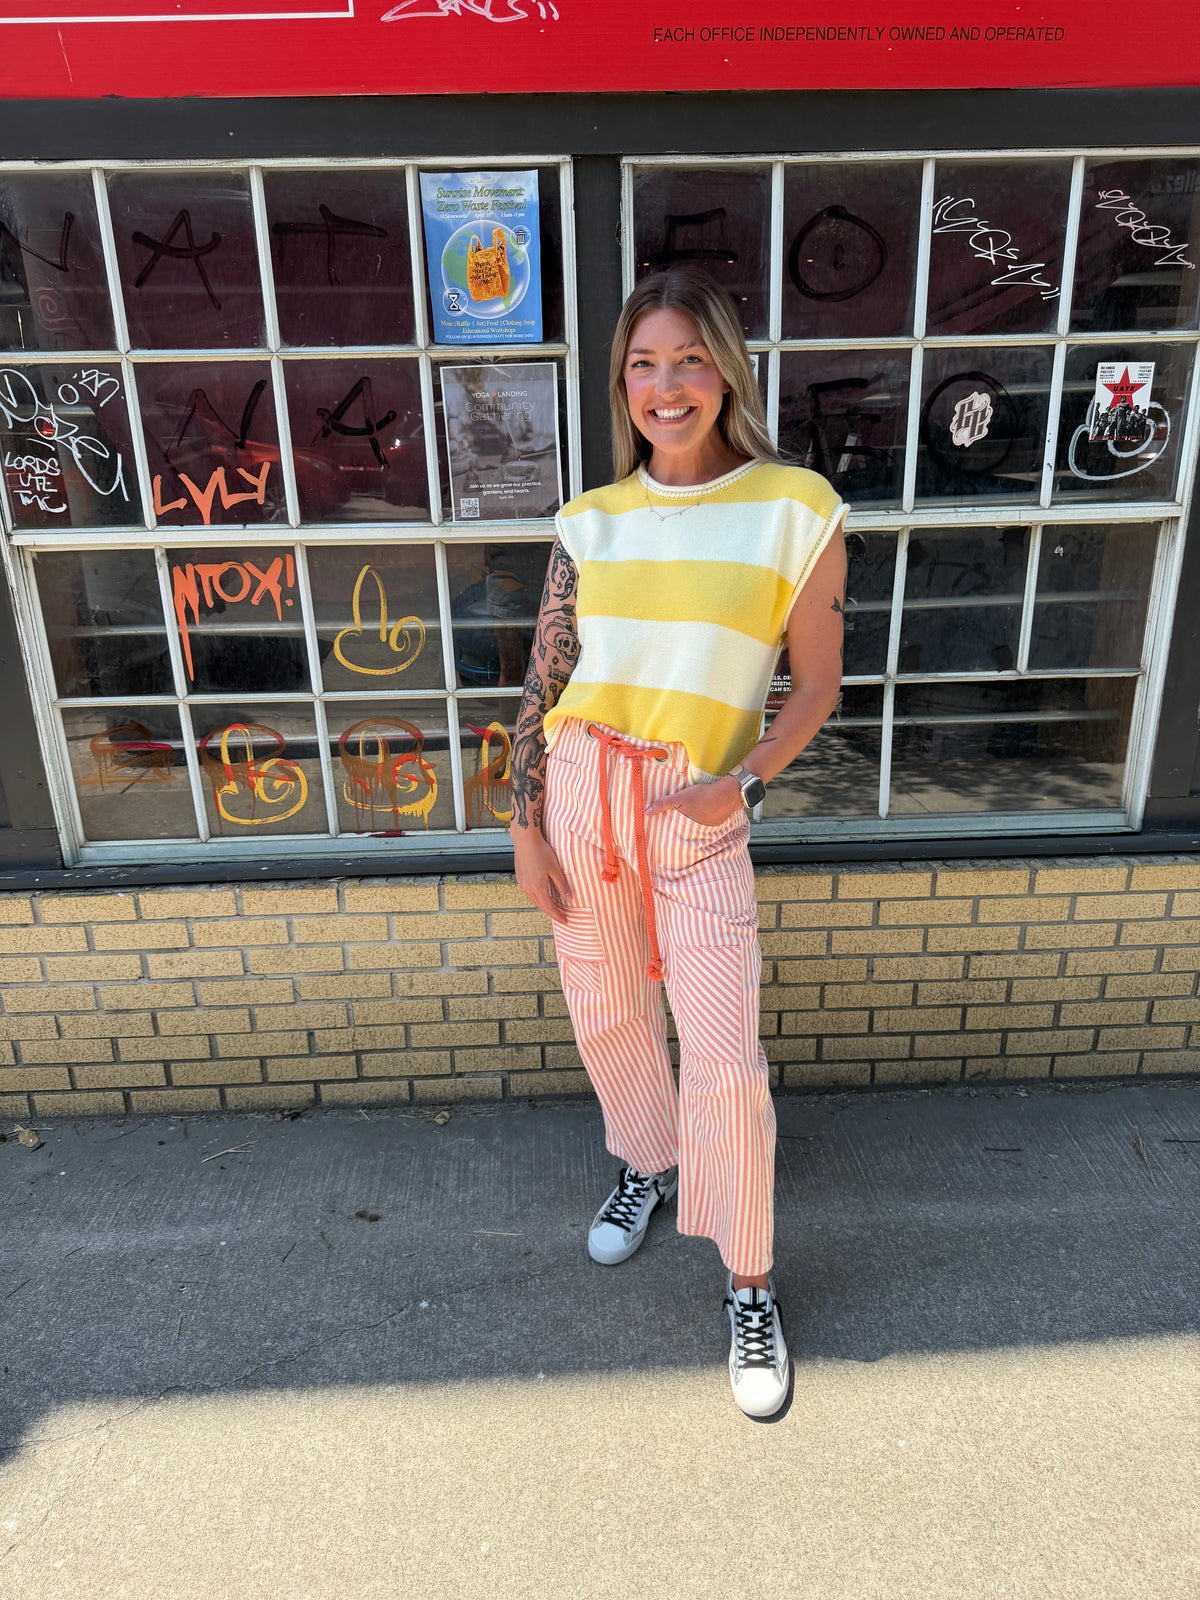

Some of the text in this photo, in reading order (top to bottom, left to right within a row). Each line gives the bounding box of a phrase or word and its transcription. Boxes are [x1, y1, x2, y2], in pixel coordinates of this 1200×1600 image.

[653, 26, 1065, 42] EACH OFFICE INDEPENDENTLY OWNED AND OPERATED
[436, 186, 471, 199] Sunrise
[436, 198, 527, 212] Zero Waste Festival
[502, 319, 522, 327] Clothing
[464, 399, 536, 412] Community
[470, 409, 532, 422] Gathering
[4, 451, 62, 476] LORDS
